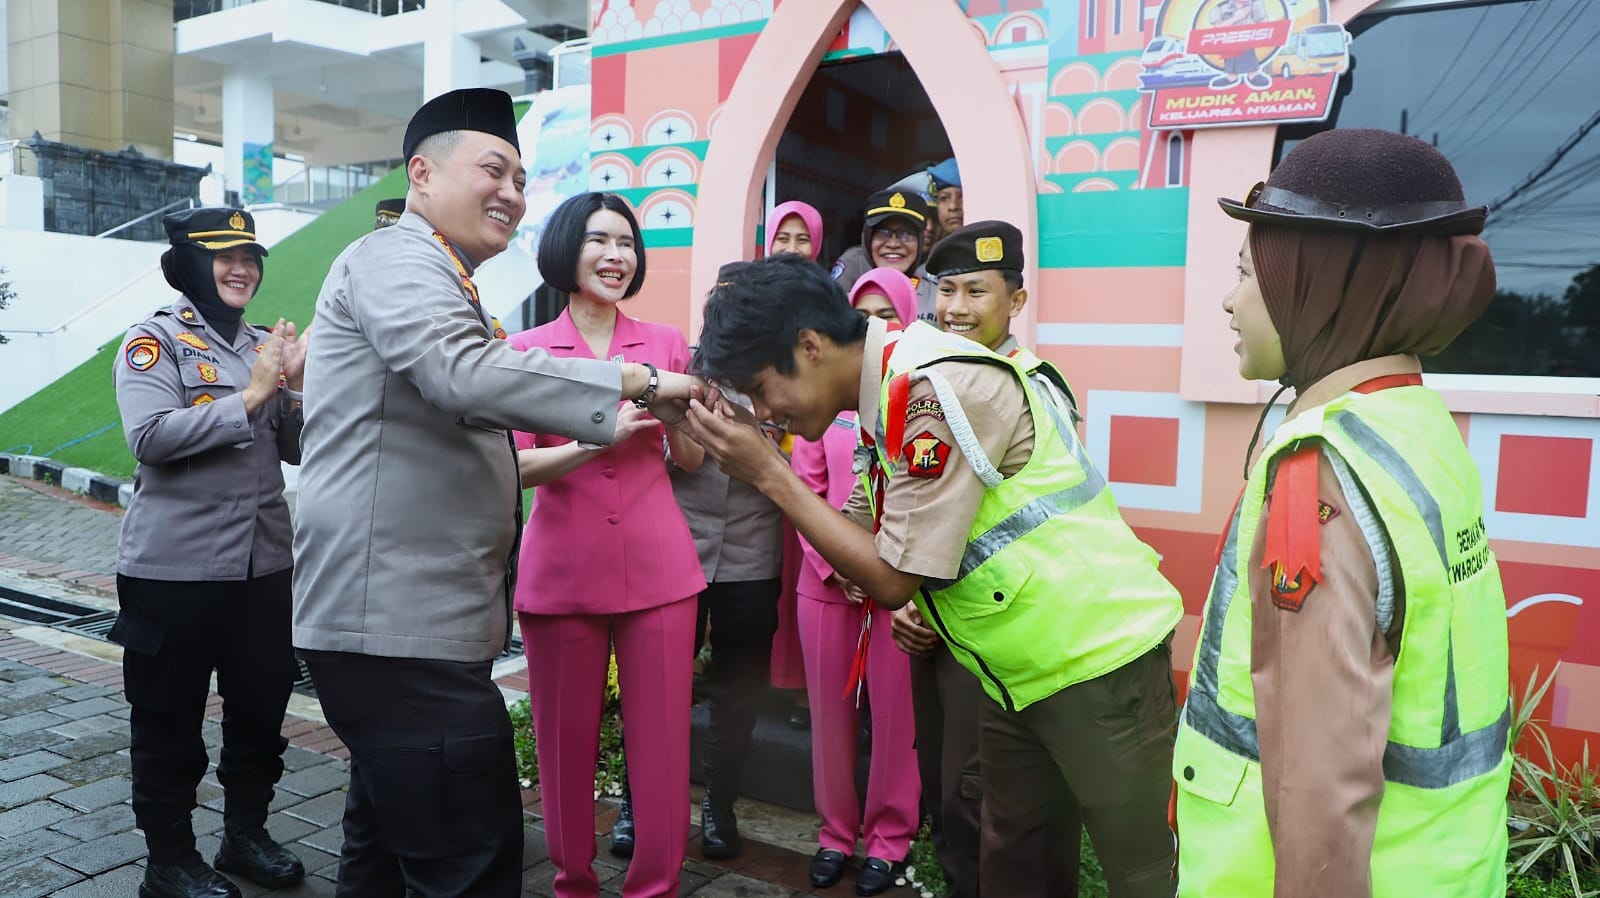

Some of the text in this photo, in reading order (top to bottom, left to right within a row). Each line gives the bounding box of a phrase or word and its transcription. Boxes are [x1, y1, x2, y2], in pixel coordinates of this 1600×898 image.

[1200, 27, 1275, 47] PRESISI
[1165, 87, 1316, 110] MUDIK AMAN,
[1159, 101, 1318, 121] KELUARGA NYAMAN
[182, 347, 221, 365] DIANA
